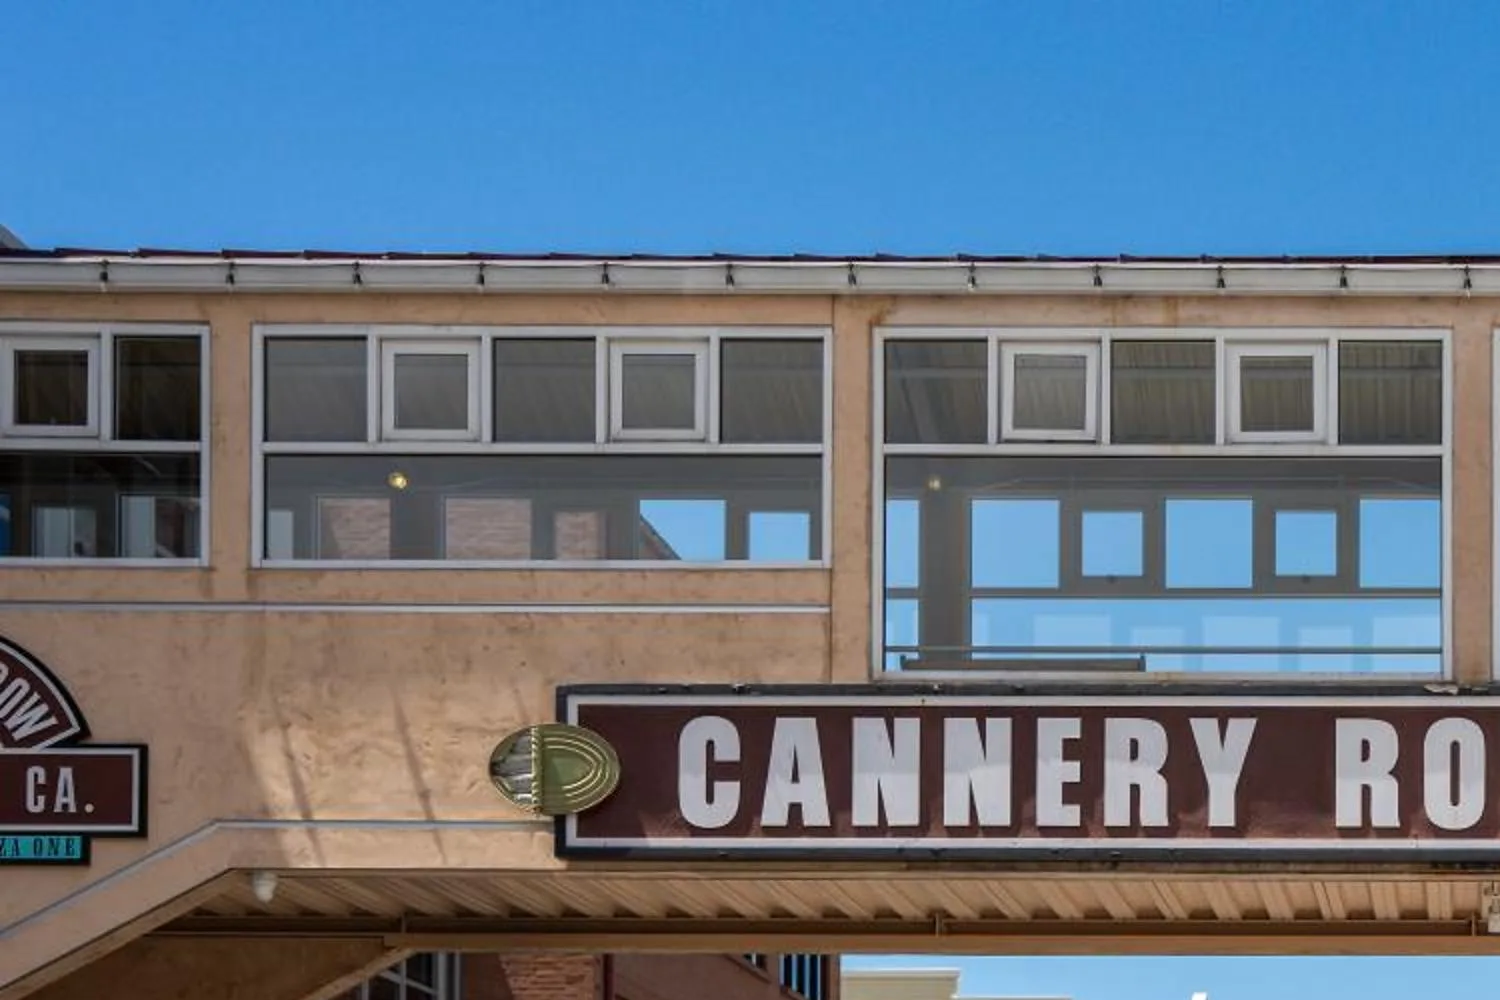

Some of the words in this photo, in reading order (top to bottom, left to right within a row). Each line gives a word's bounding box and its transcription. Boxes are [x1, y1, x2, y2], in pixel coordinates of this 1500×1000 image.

[0, 661, 59, 741] OW
[26, 765, 95, 813] CA.
[677, 715, 1258, 828] CANNERY
[33, 838, 76, 857] ONE
